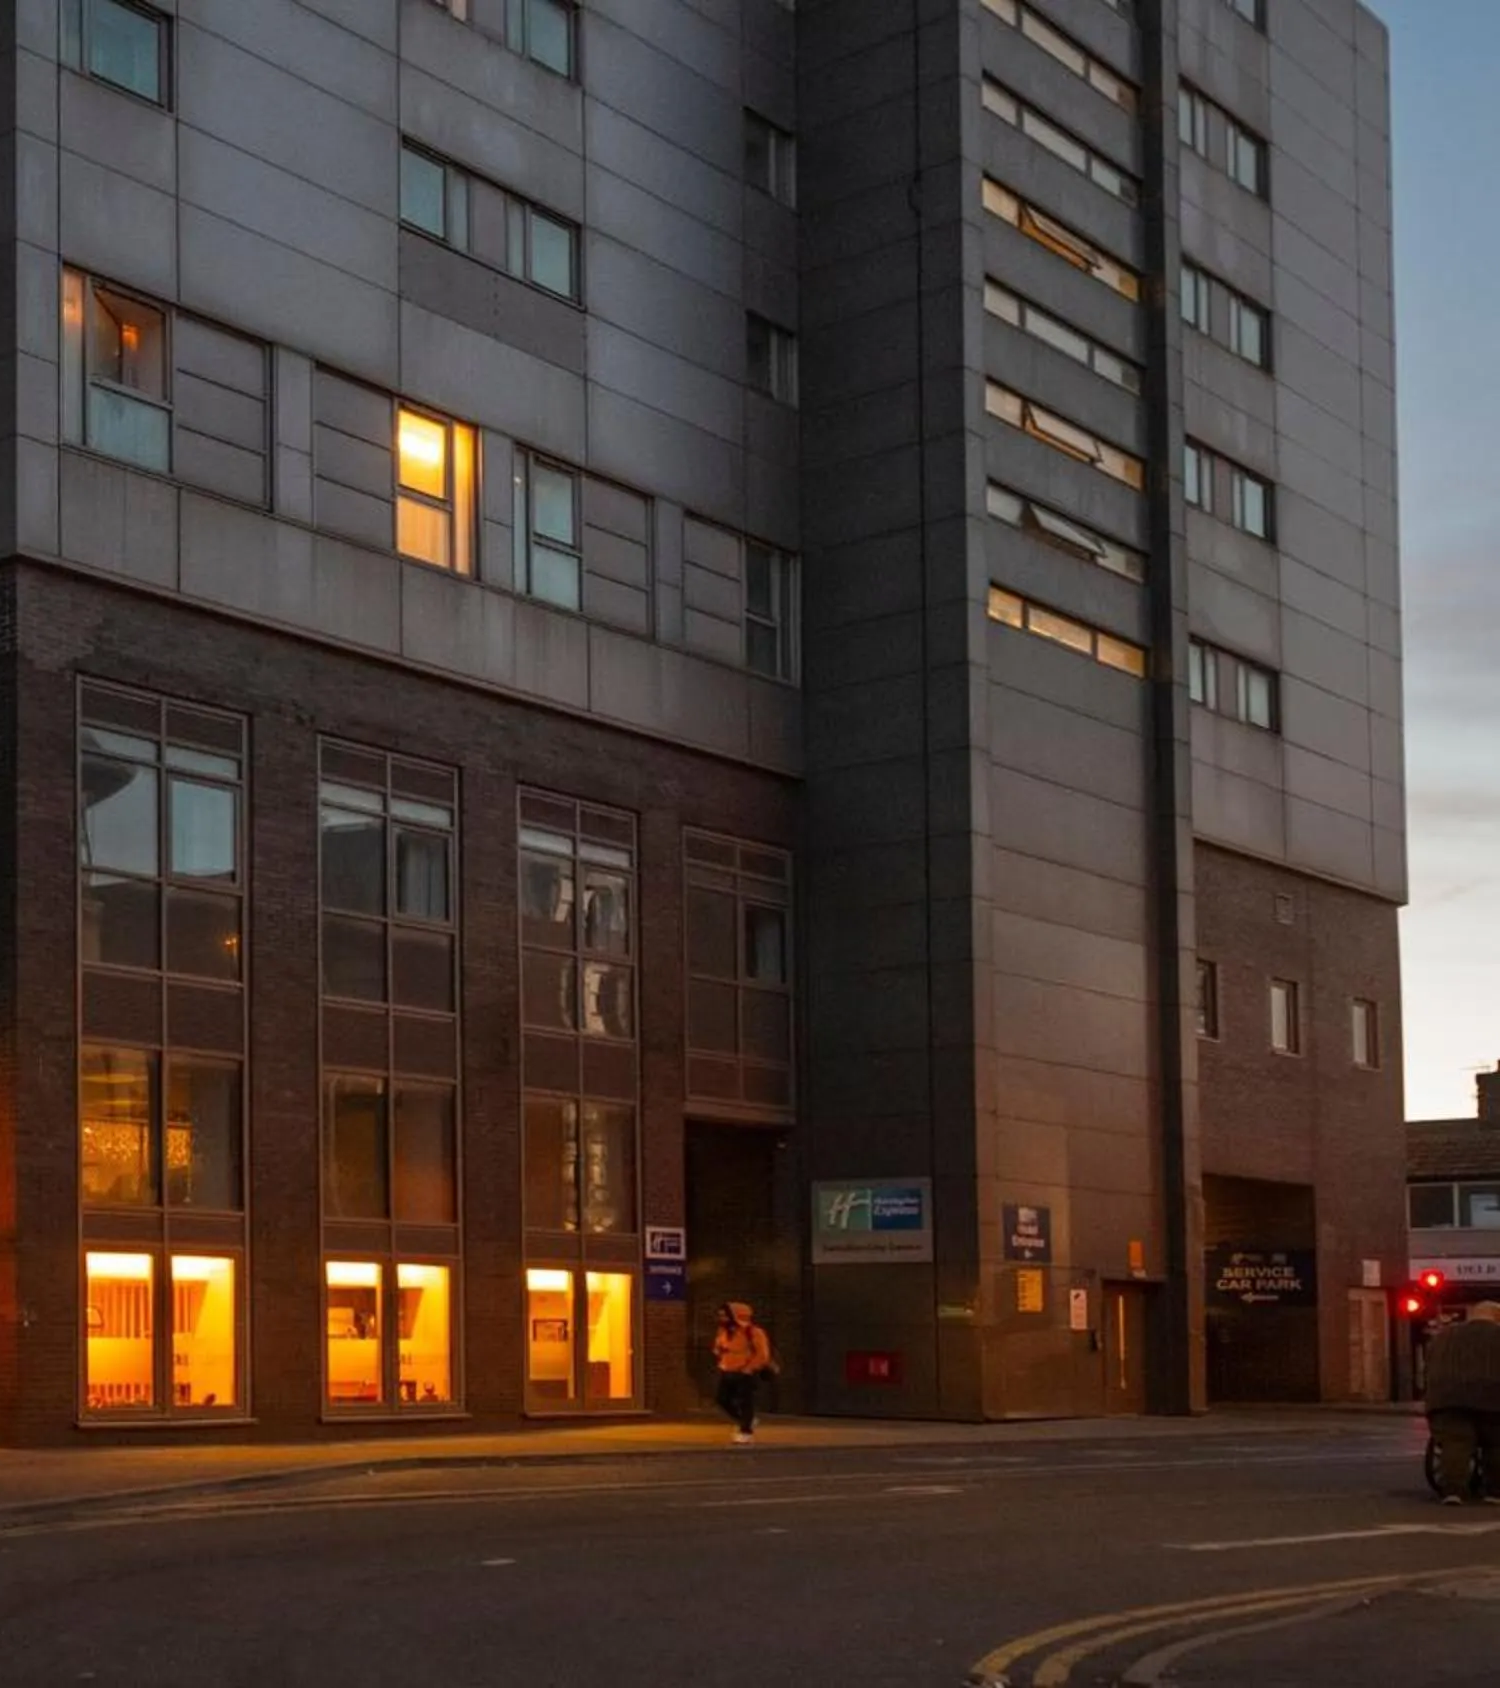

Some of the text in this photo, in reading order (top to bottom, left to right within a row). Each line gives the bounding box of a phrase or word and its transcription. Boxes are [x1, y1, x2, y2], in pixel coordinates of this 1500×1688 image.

[1222, 1266, 1296, 1278] SERVICE
[1216, 1278, 1302, 1291] CAR PARK
